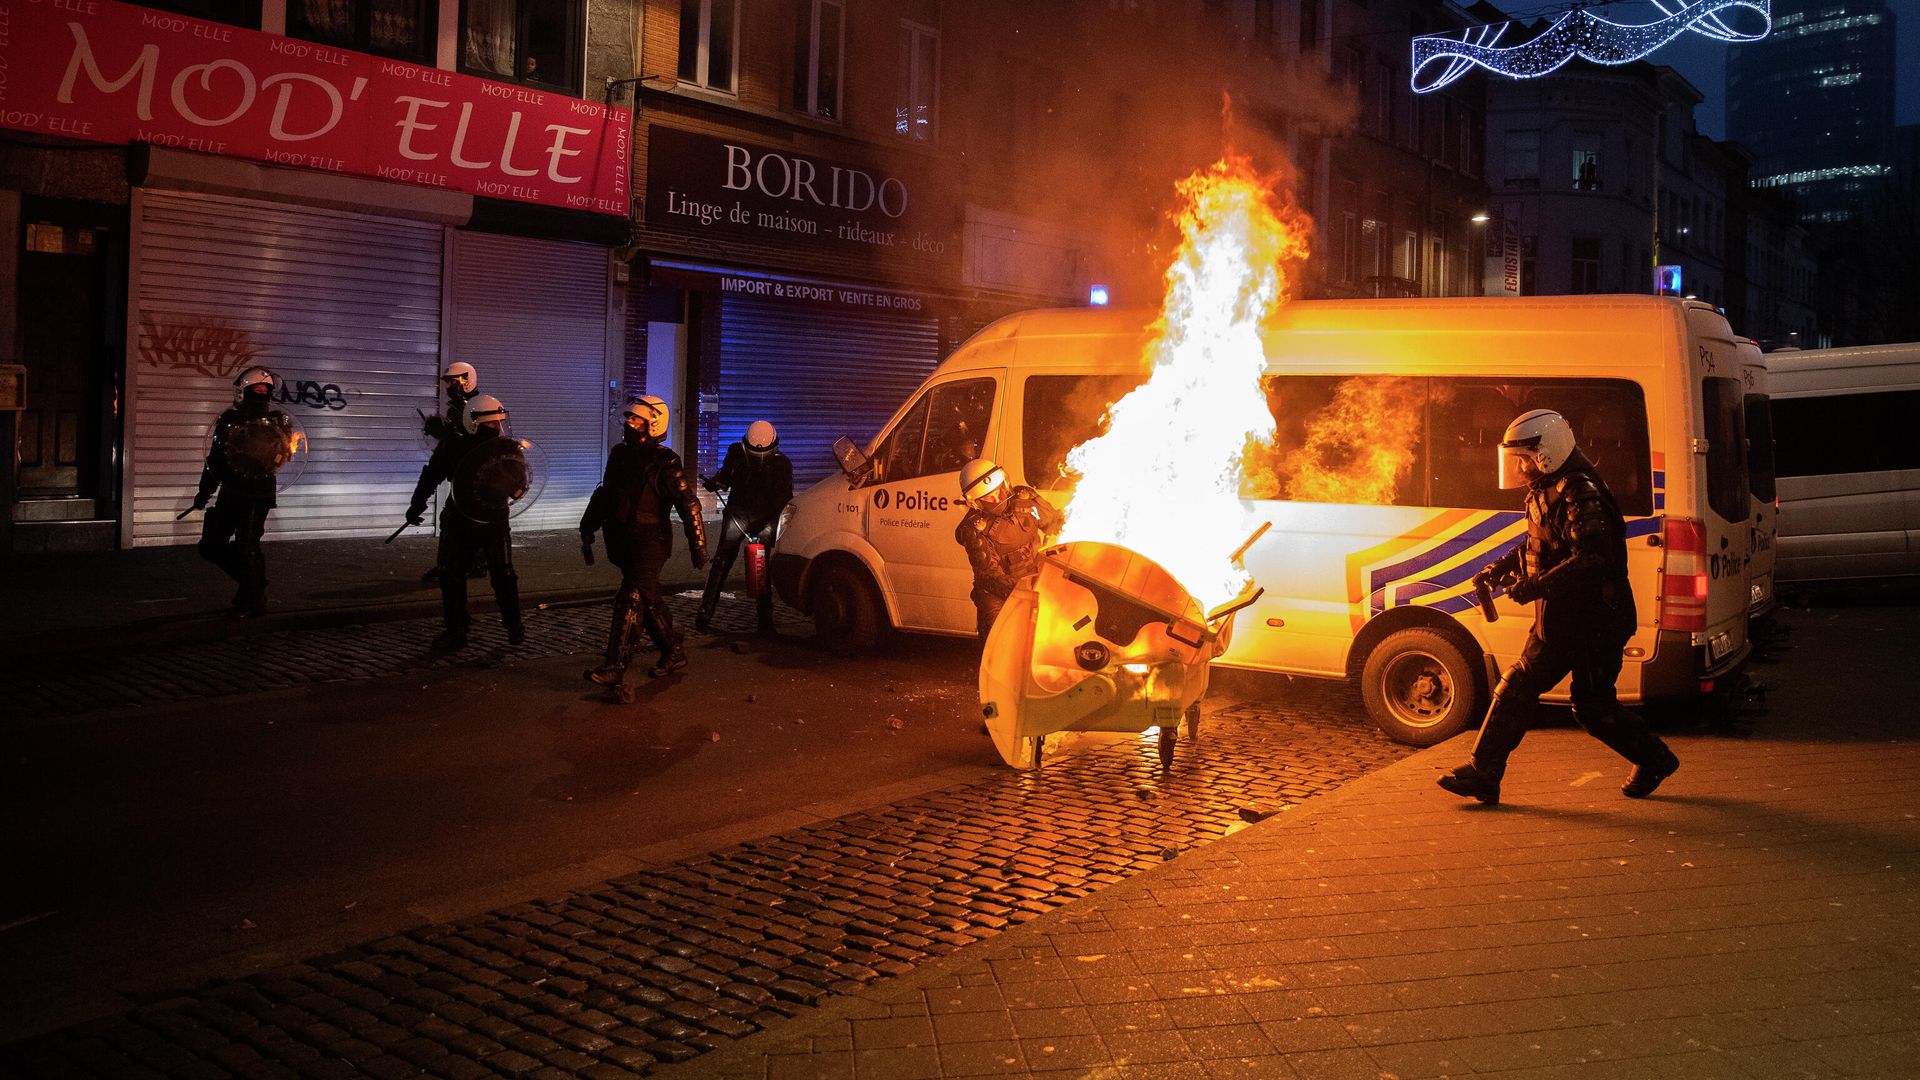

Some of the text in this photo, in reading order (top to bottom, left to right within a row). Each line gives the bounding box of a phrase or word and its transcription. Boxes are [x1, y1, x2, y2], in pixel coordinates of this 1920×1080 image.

[142, 12, 232, 42] MOD' ELLE
[270, 39, 350, 66] MOD' ELLE
[382, 62, 452, 87] MOD' ELLE
[57, 22, 592, 184] MOD' ELLE
[481, 82, 545, 106] MOD' ELLE
[571, 101, 600, 116] MOD'
[48, 116, 94, 135] ELLE
[137, 128, 228, 155] MOD' ELLE
[264, 148, 345, 171] MOD' ELLE
[615, 127, 627, 196] MOD' ELLE
[376, 163, 447, 187] MOD' ELLE
[721, 143, 908, 219] BORIDO
[476, 180, 540, 200] MOD' ELLE
[566, 193, 624, 212] MOD' ELLE
[667, 190, 722, 226] Linge
[729, 201, 751, 224] de
[757, 210, 818, 236] maison
[838, 220, 895, 248] rideaux
[912, 231, 945, 254] déco
[1504, 236, 1518, 292] ECHOSTAR
[721, 277, 922, 311] IMPORT & EXPORT VENTE EN GROS
[846, 504, 859, 513] 101
[896, 490, 949, 511] Police
[880, 518, 931, 529] Police Fédérale
[1721, 551, 1741, 579] Police
